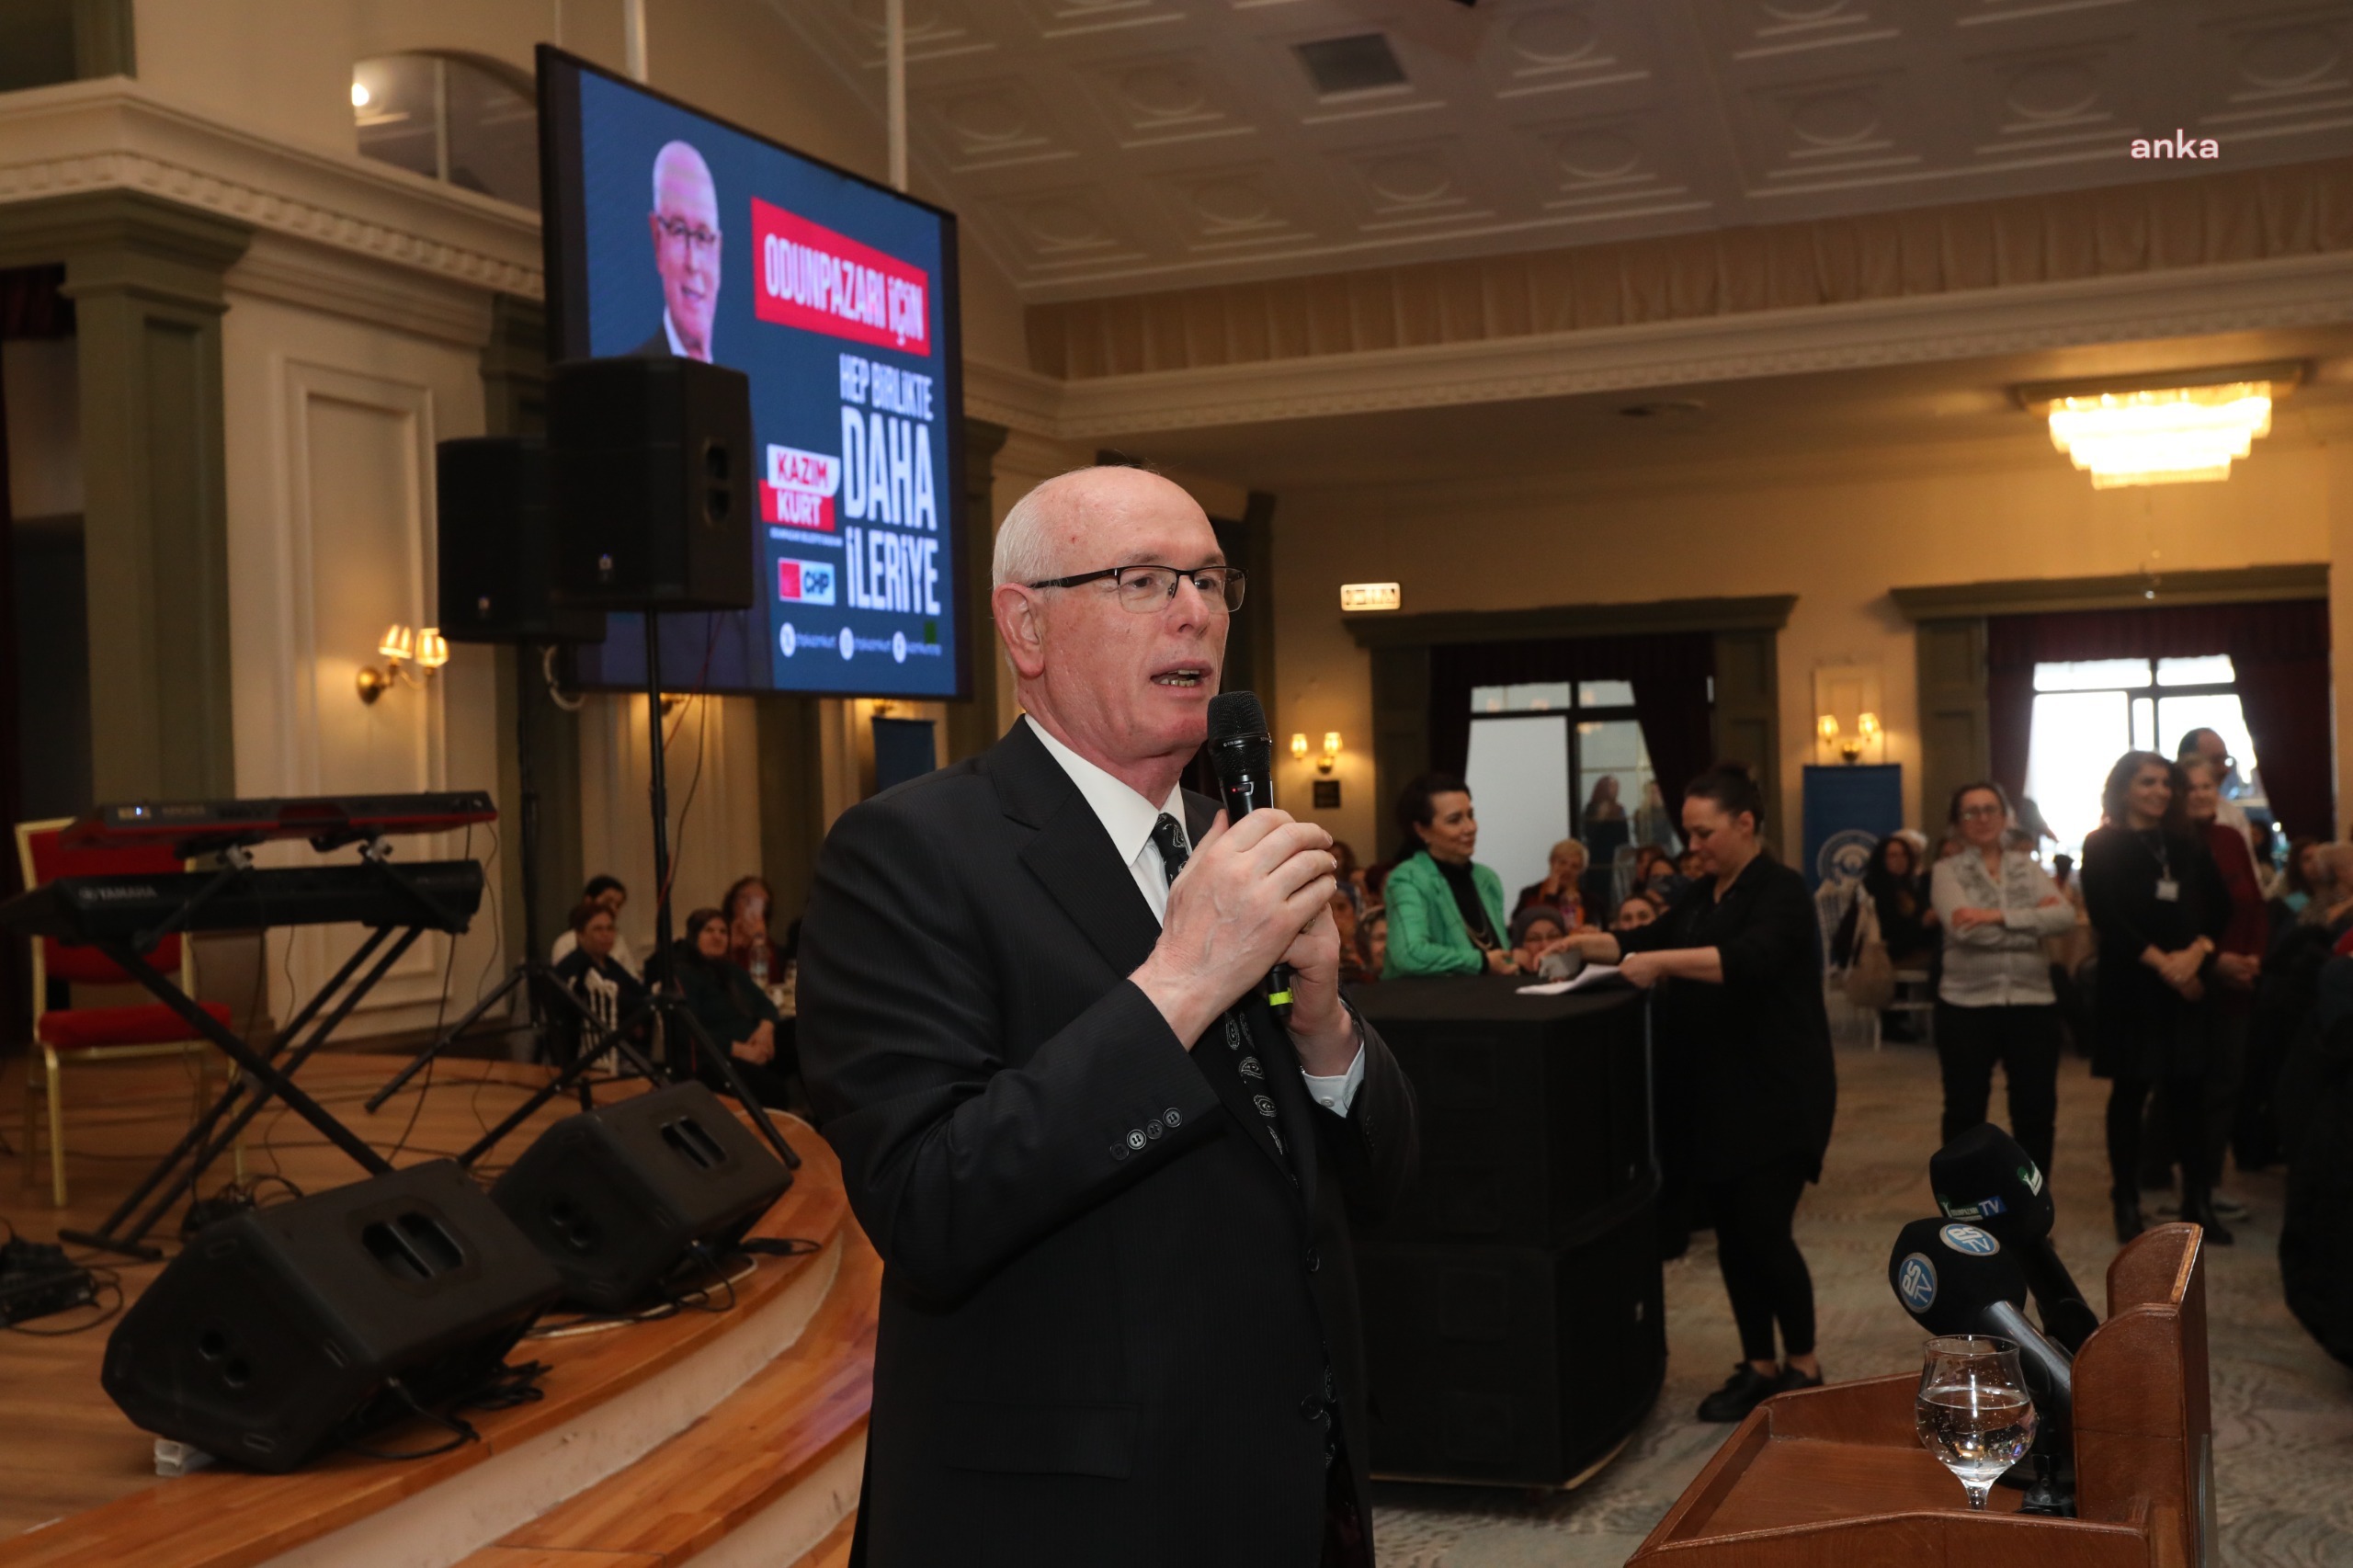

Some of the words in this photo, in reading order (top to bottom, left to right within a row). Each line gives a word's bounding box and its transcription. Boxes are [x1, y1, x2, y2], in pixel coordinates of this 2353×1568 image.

[765, 233, 886, 329] ODUNPAZARI
[839, 353, 870, 403] HEP
[777, 451, 829, 488] KAZIM
[841, 405, 938, 530] DAHA
[777, 488, 823, 527] KURT
[803, 571, 830, 595] CHP
[845, 526, 941, 616] İLERİYE
[1978, 1199, 1999, 1217] TV
[1962, 1238, 1990, 1253] TV
[1914, 1273, 1932, 1303] TV
